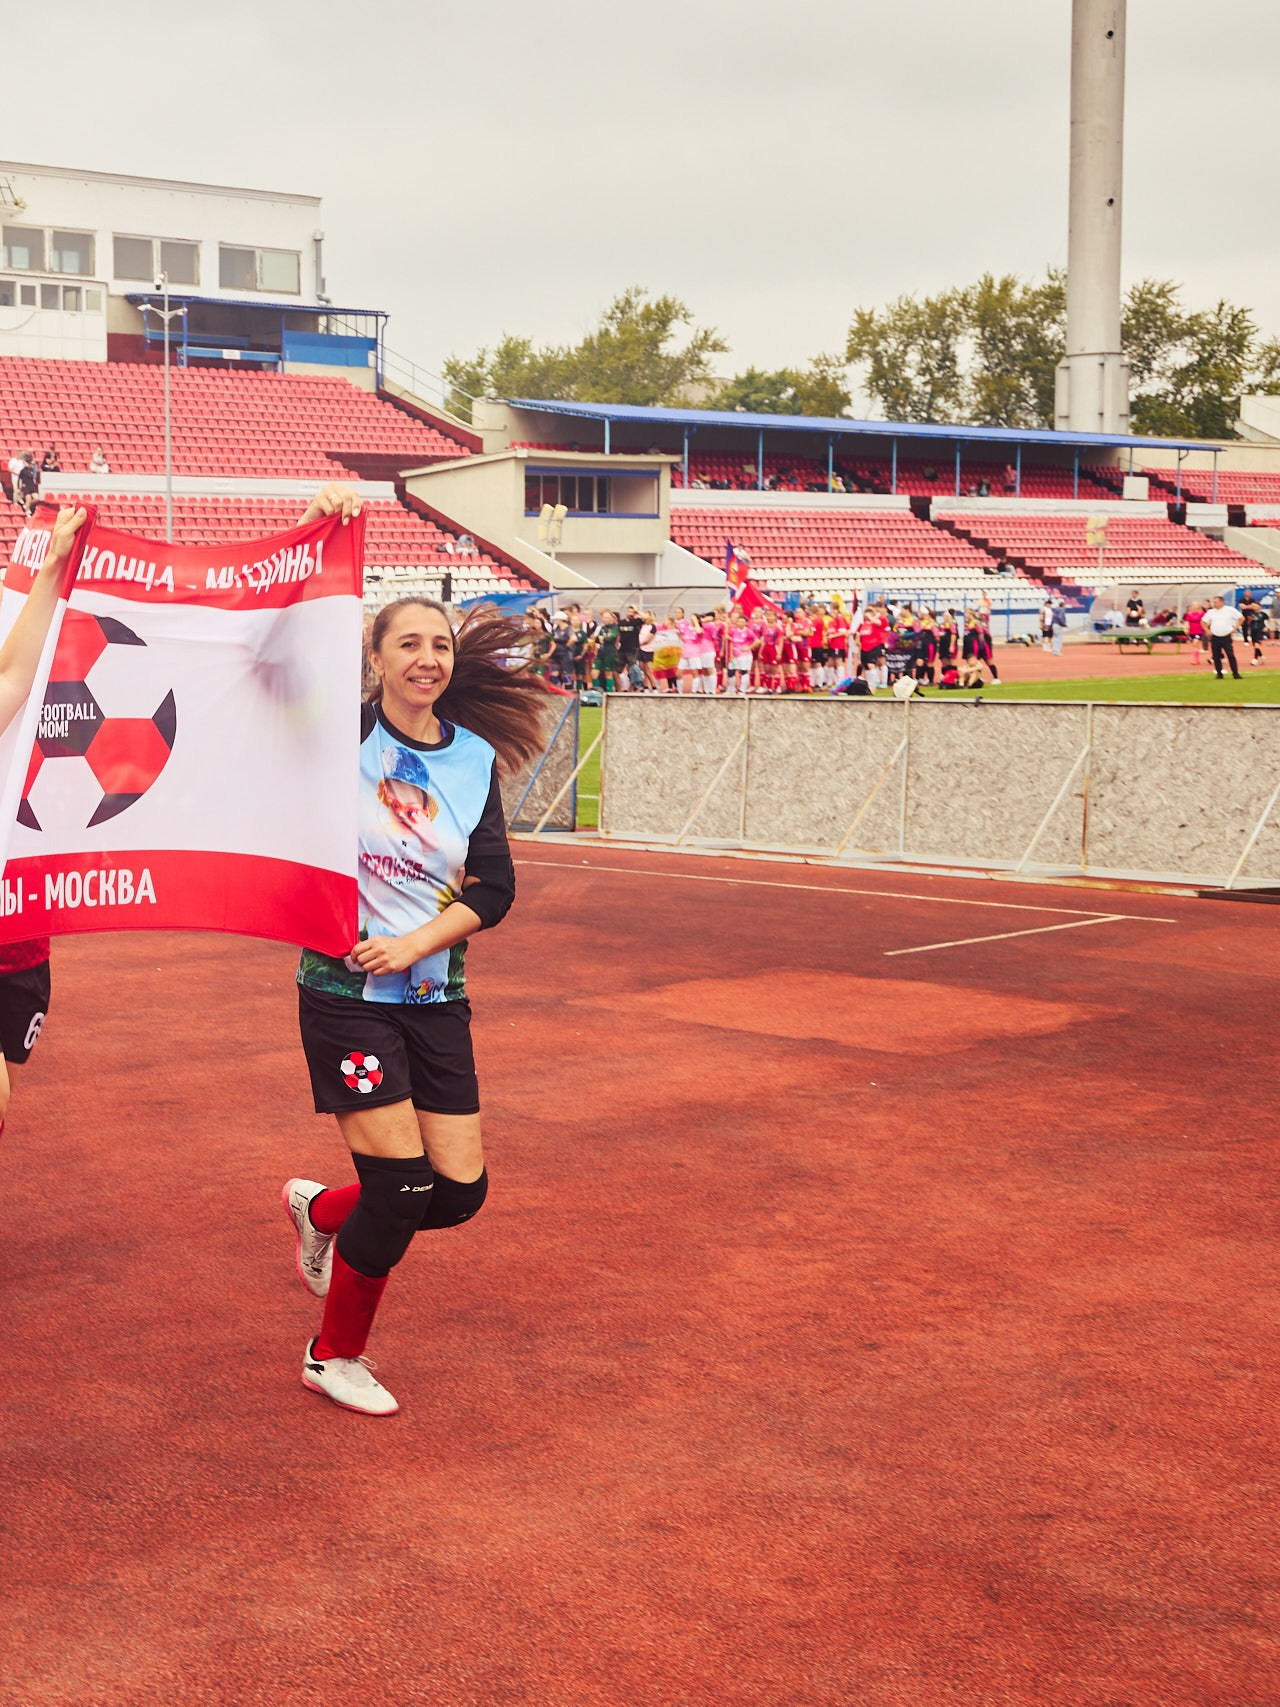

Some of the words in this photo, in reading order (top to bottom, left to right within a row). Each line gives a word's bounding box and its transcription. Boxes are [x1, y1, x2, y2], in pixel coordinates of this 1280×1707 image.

[76, 543, 175, 593] КОНЦА
[38, 720, 69, 739] MOM!
[39, 702, 97, 722] FOOTBALL
[44, 868, 158, 911] МОСКВА
[24, 1011, 45, 1050] 6
